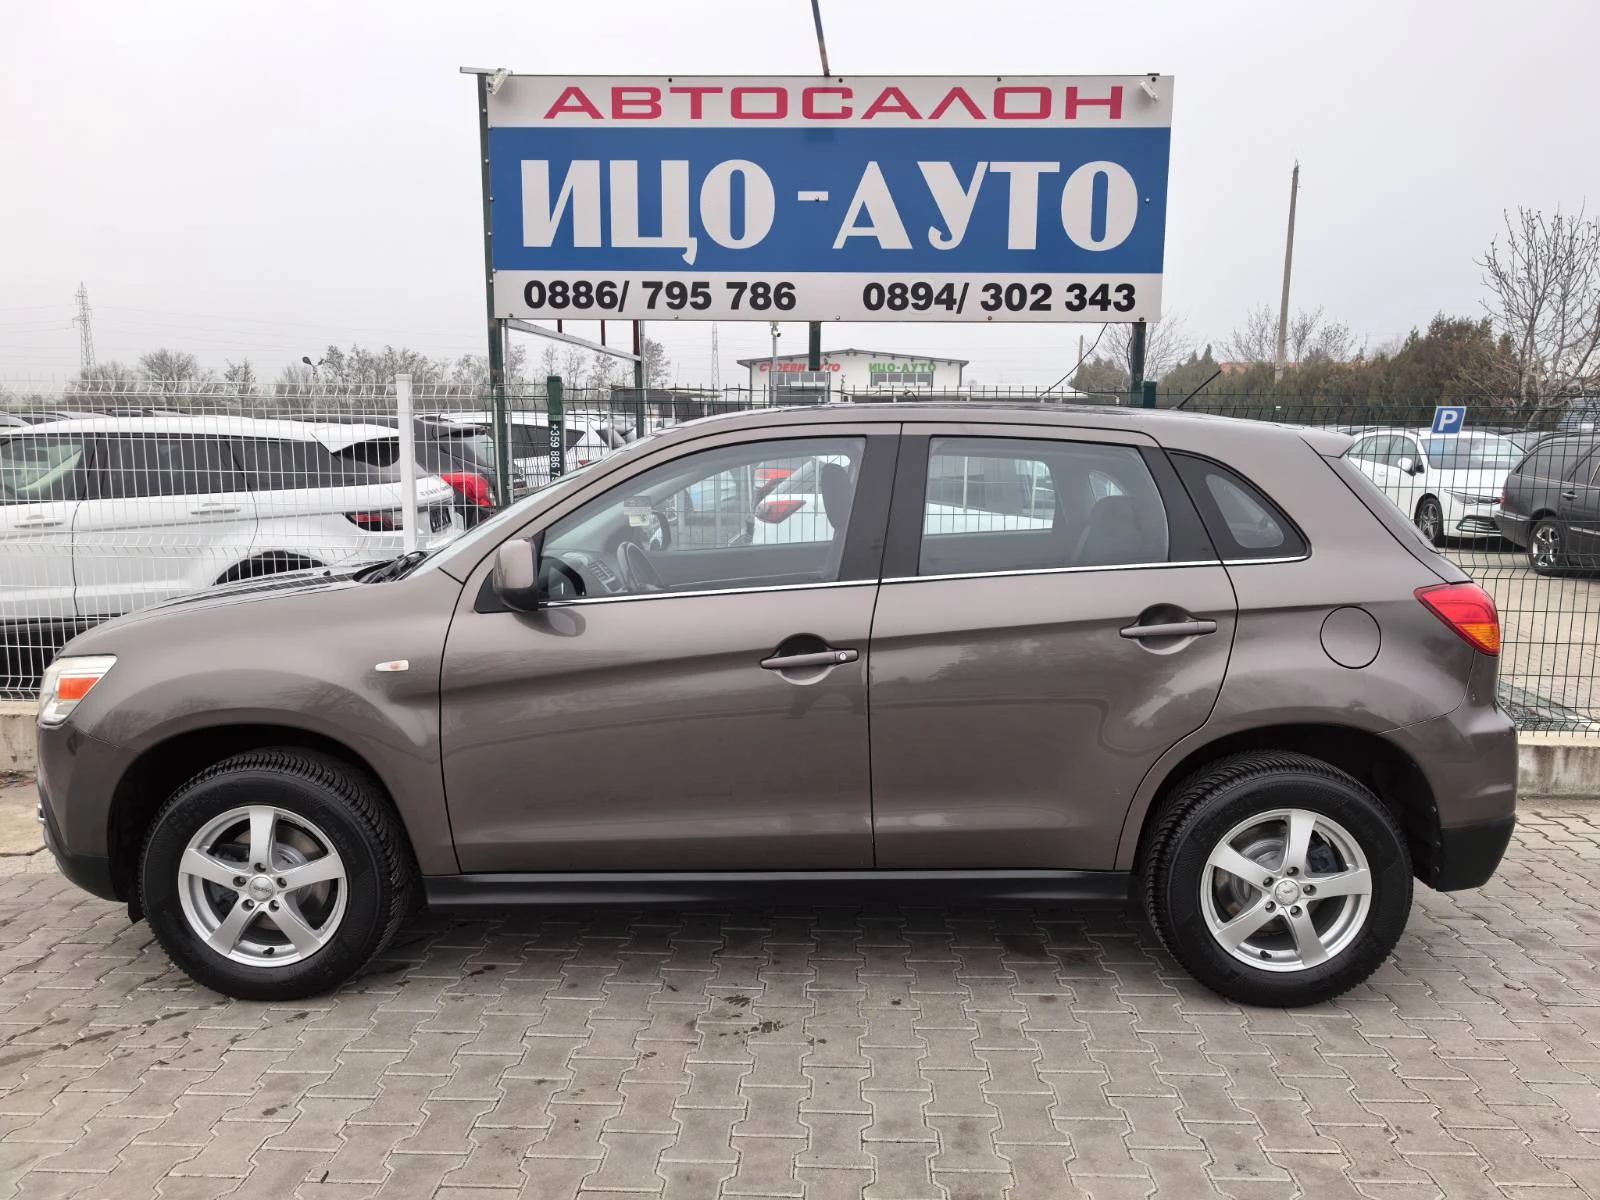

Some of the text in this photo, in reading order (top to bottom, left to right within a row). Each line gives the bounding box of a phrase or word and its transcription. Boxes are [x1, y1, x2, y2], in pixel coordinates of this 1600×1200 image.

[543, 86, 1124, 121] АВТОСАЛОН
[523, 280, 797, 313] 0886/ 795 786
[862, 281, 1136, 315] 0894/ 302 343
[869, 362, 937, 373] ИЦО-АУТО
[1437, 410, 1458, 431] P
[550, 423, 560, 448] +359
[550, 450, 561, 468] 886
